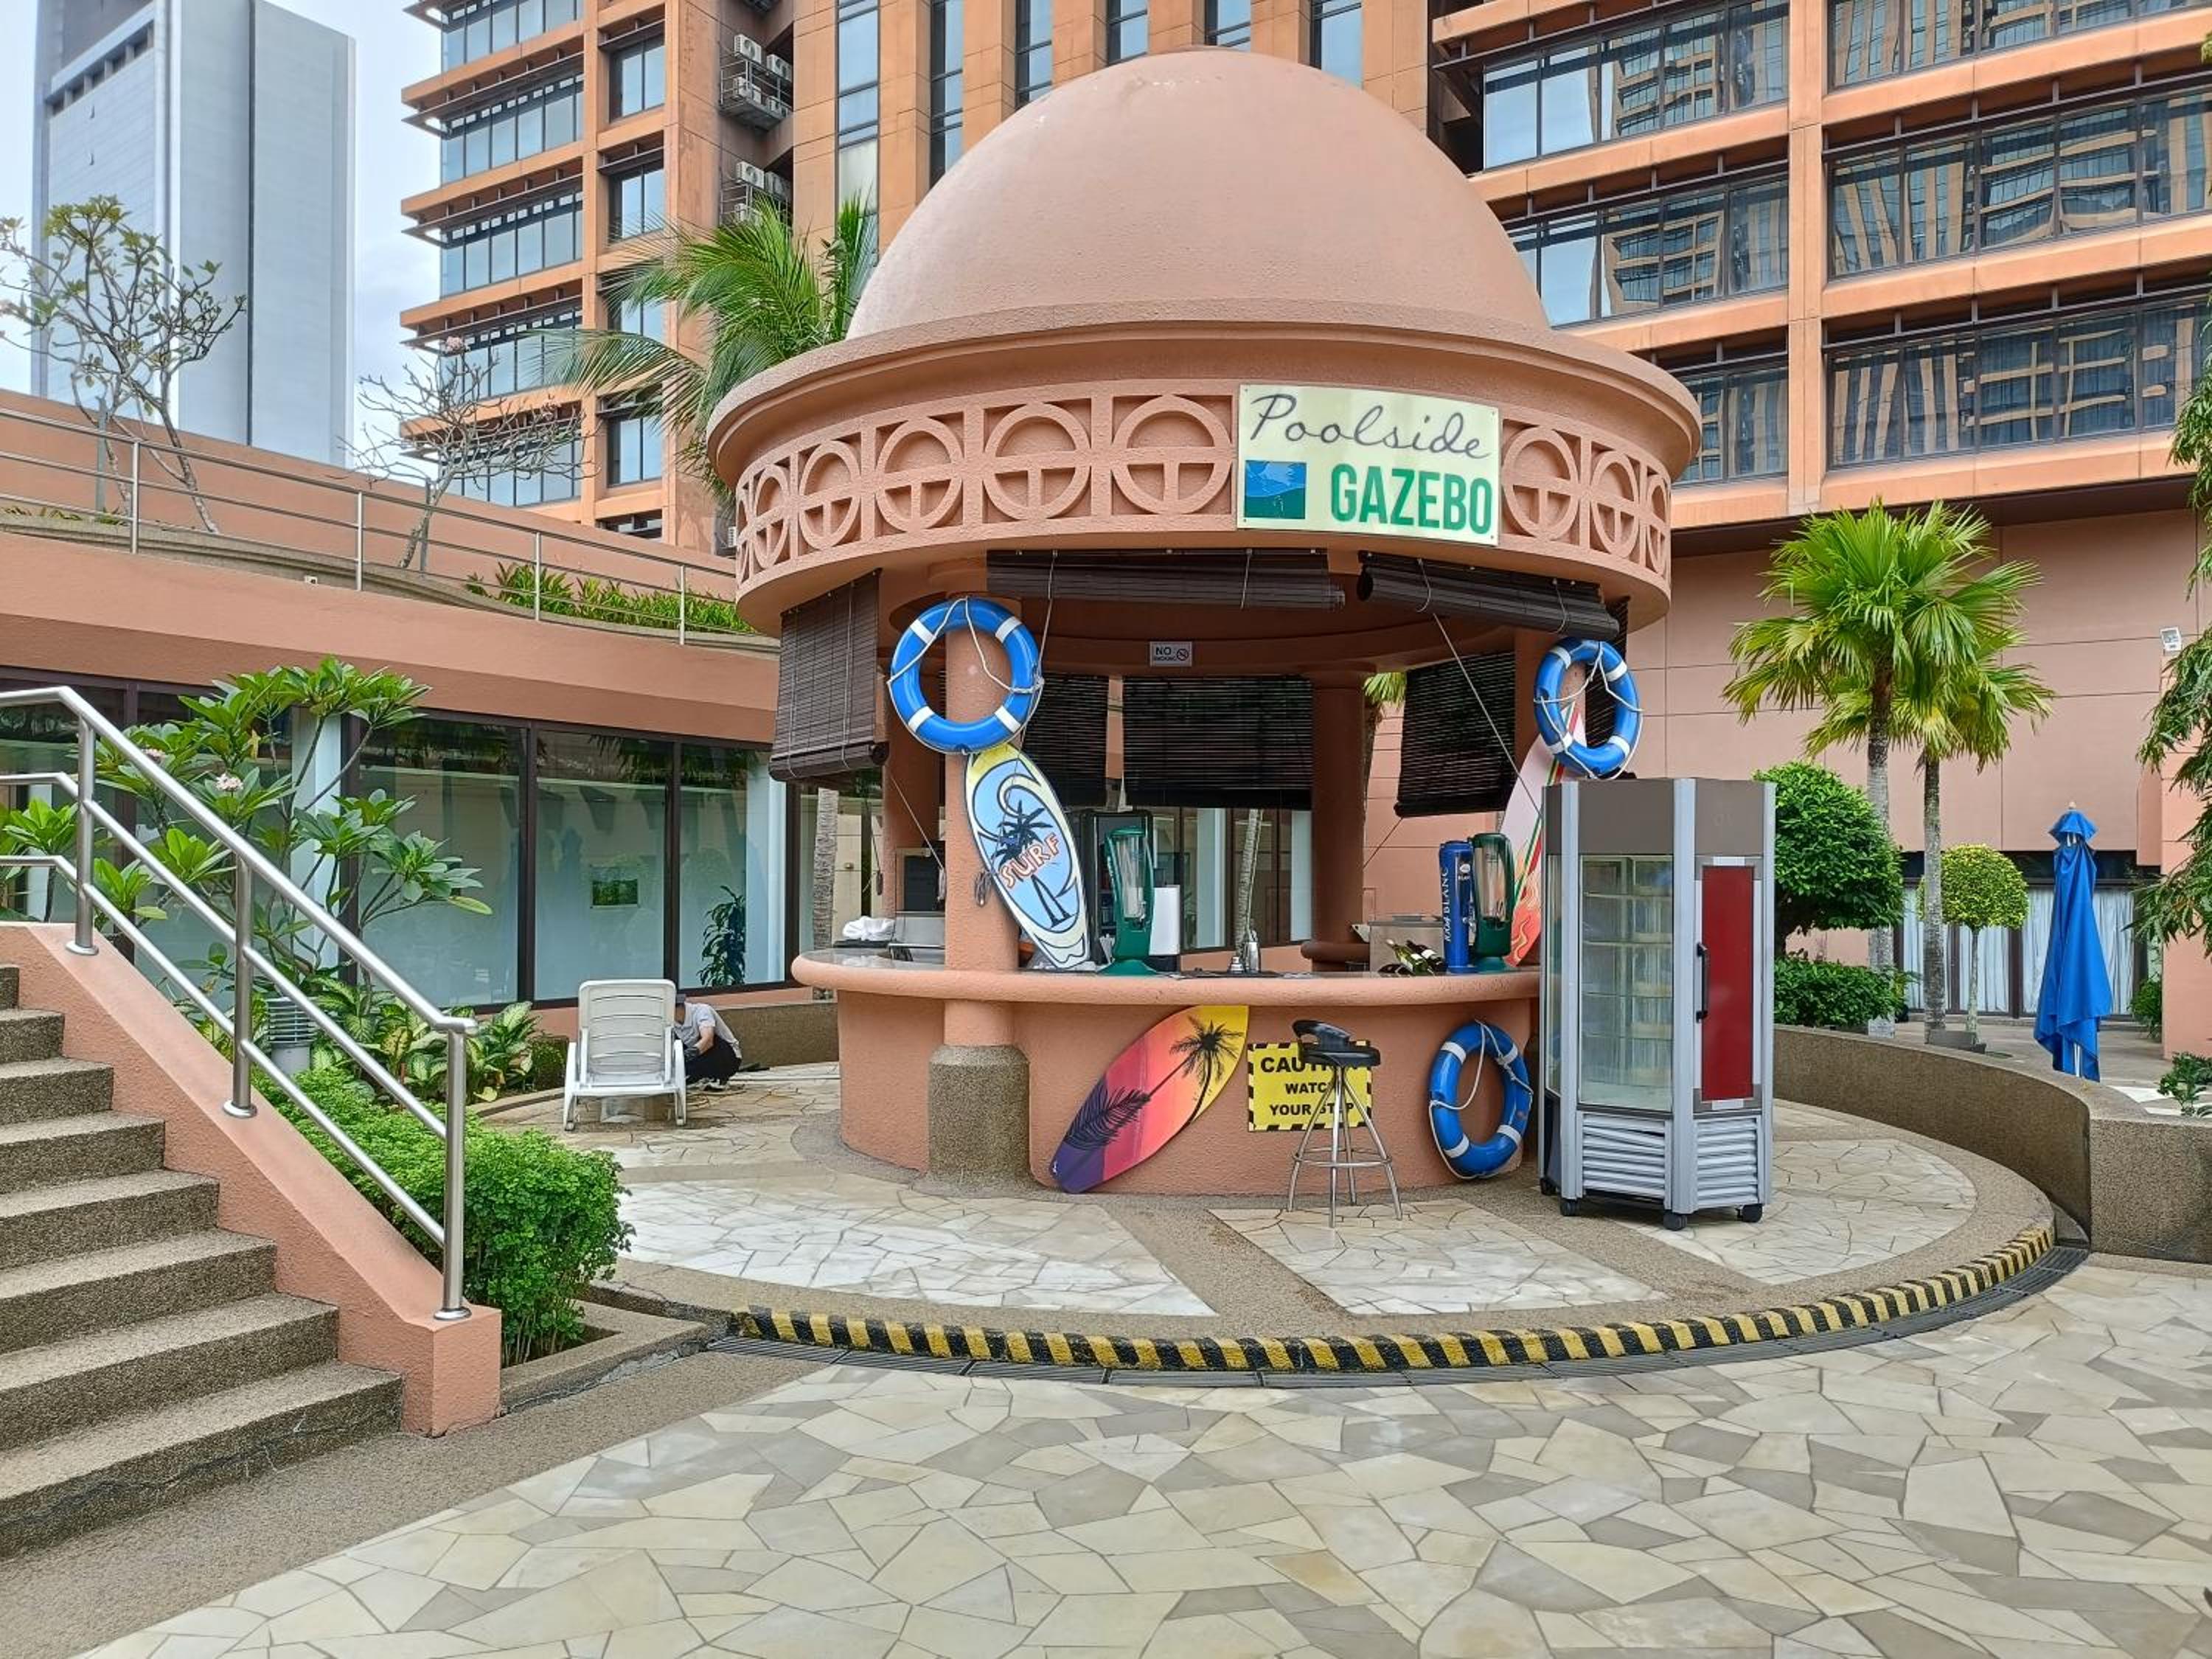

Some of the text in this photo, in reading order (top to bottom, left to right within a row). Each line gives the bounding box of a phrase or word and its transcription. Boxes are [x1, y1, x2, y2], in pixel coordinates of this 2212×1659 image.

[1250, 393, 1491, 459] Poolside
[1331, 463, 1493, 535] GAZEBO
[1155, 647, 1172, 655] NO
[1001, 832, 1060, 889] SURF
[1441, 867, 1450, 914] BLANC
[1270, 1102, 1354, 1116] YOUR STP
[1285, 1082, 1332, 1094] WATC
